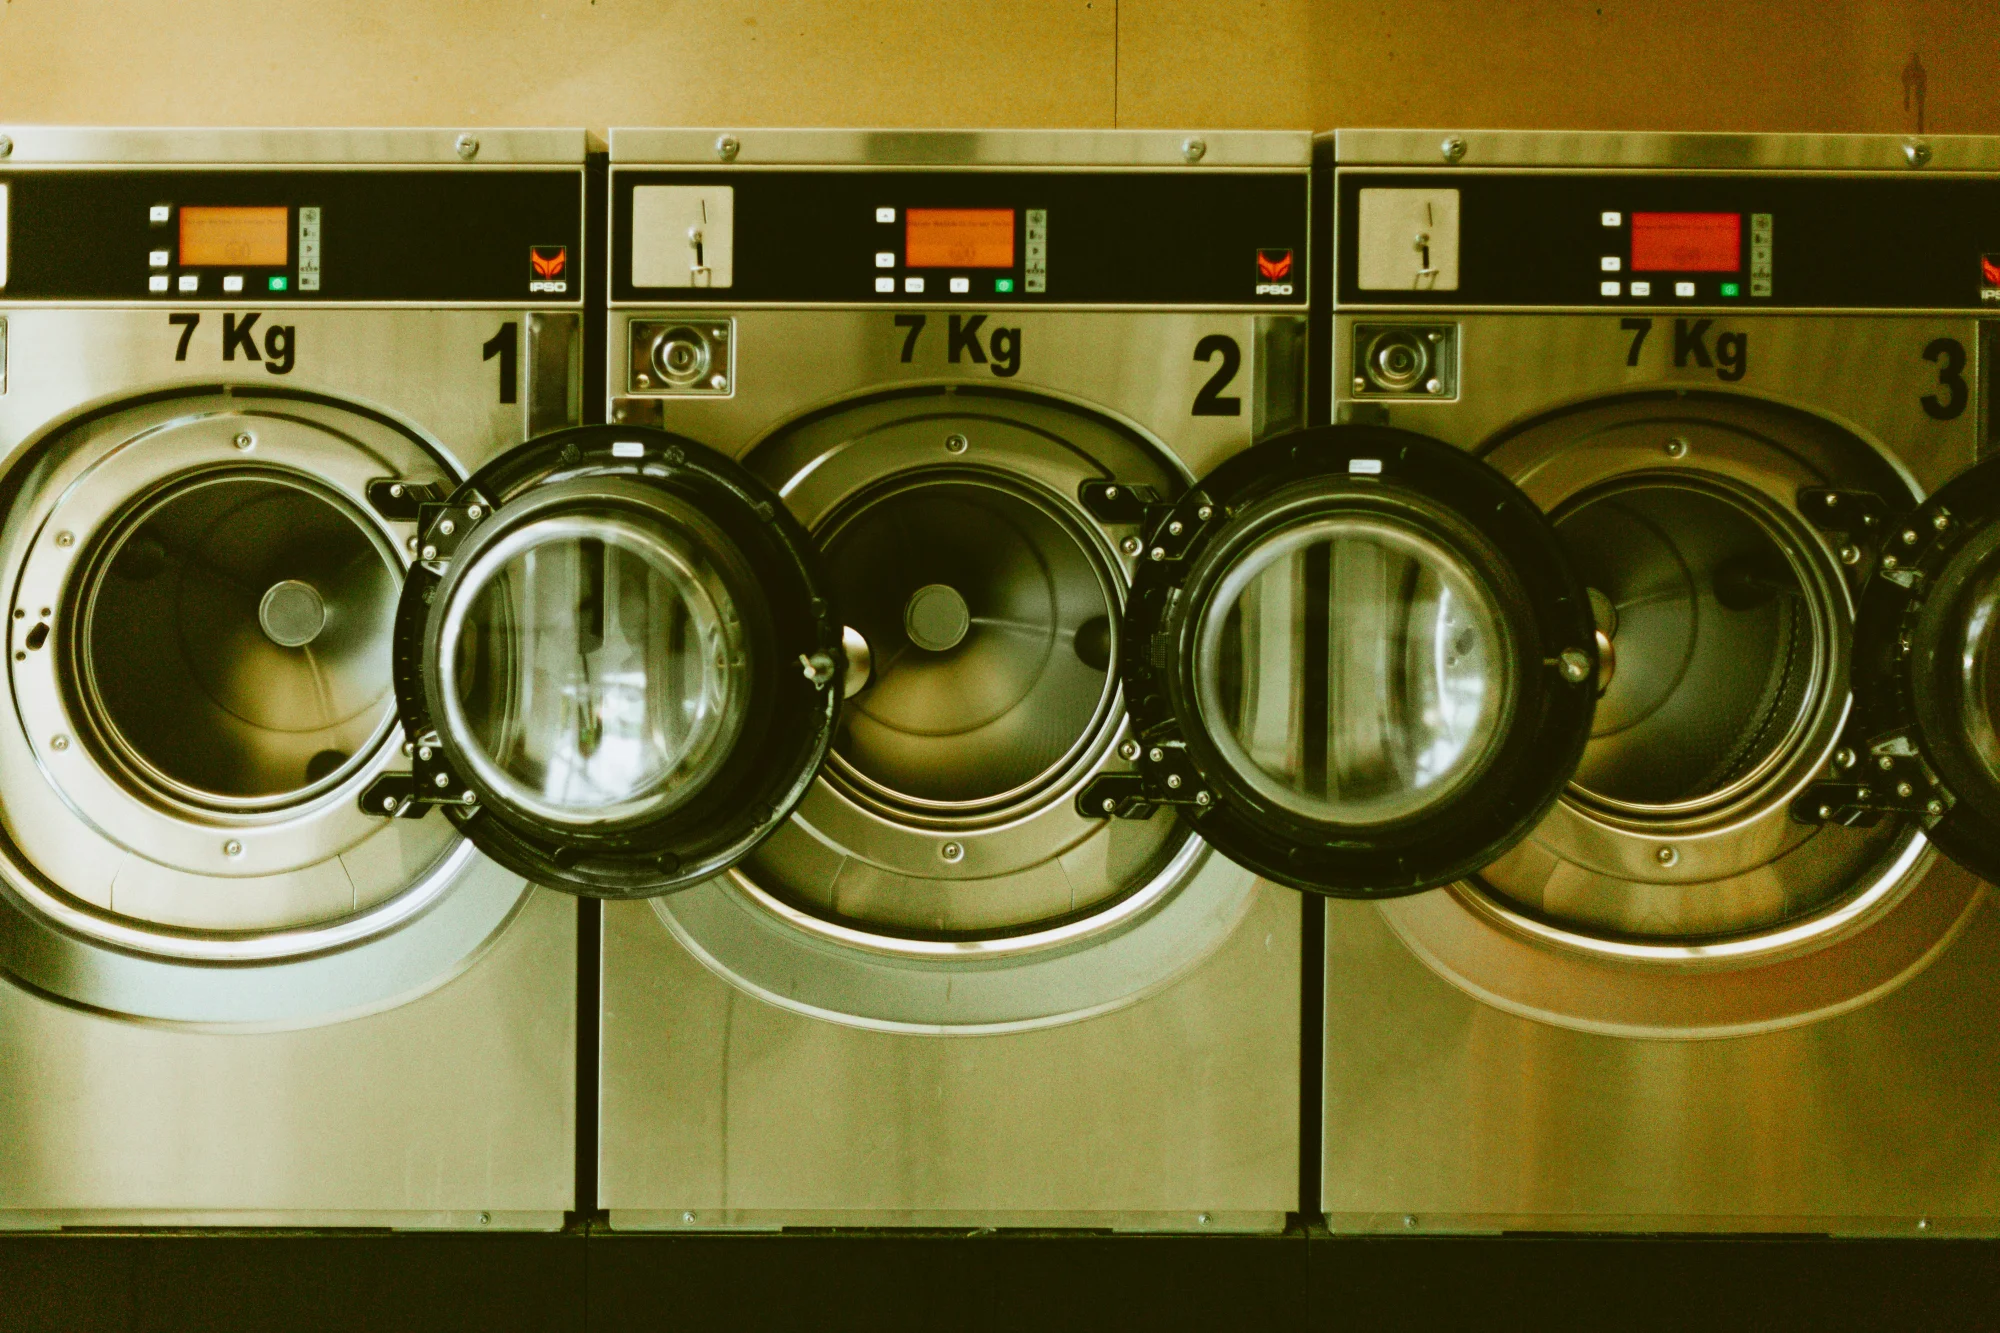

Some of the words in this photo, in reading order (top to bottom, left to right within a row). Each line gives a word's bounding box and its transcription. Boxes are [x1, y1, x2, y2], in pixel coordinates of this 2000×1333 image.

[530, 282, 567, 292] IPSO
[1256, 284, 1293, 295] IPSO
[1981, 289, 2000, 300] IP
[168, 313, 199, 361] 7
[222, 313, 296, 375] Kg
[482, 322, 518, 404] 1
[893, 315, 926, 364] 7
[947, 315, 1022, 377] Kg
[1191, 334, 1241, 416] 2
[1620, 318, 1652, 367] 7
[1673, 318, 1748, 382] Kg
[1919, 337, 1969, 421] 3
